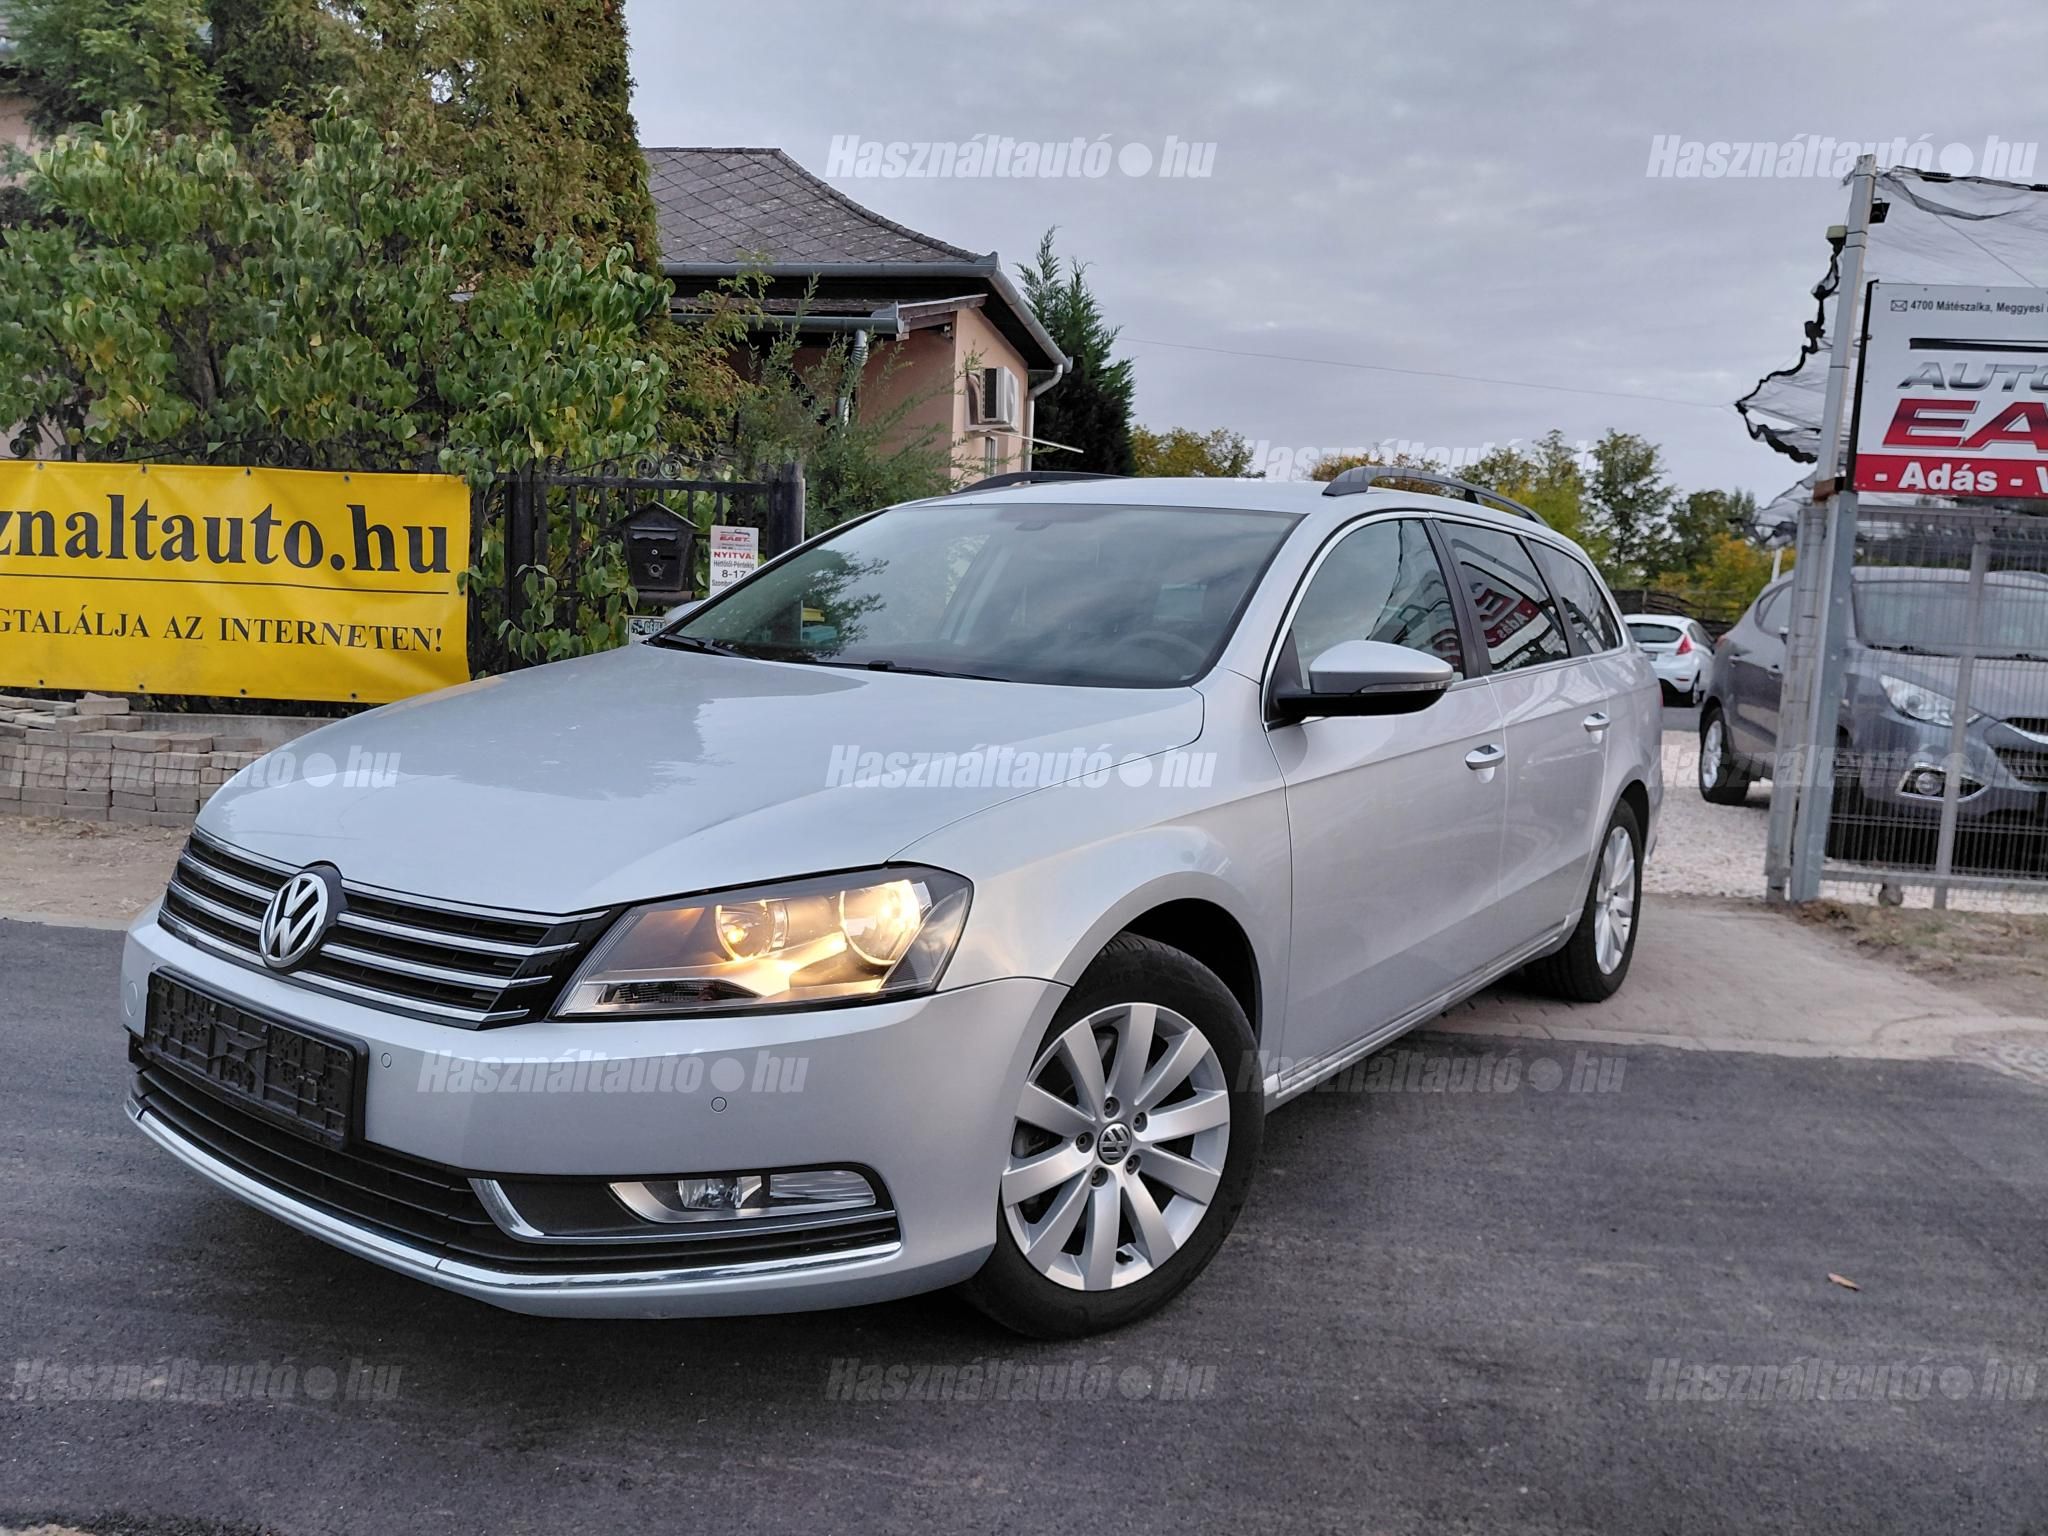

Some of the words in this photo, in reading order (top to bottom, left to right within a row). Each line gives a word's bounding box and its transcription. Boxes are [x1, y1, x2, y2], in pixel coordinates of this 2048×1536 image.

[1911, 300, 1934, 310] 4700
[1937, 301, 1993, 313] Mátészalka,
[1996, 303, 2044, 315] Meggyesi
[1898, 461, 1998, 493] Adás
[714, 551, 755, 559] NYITVA:
[722, 569, 746, 578] 8-17
[163, 616, 203, 640] AZ
[219, 616, 442, 653] INTERNETEN!
